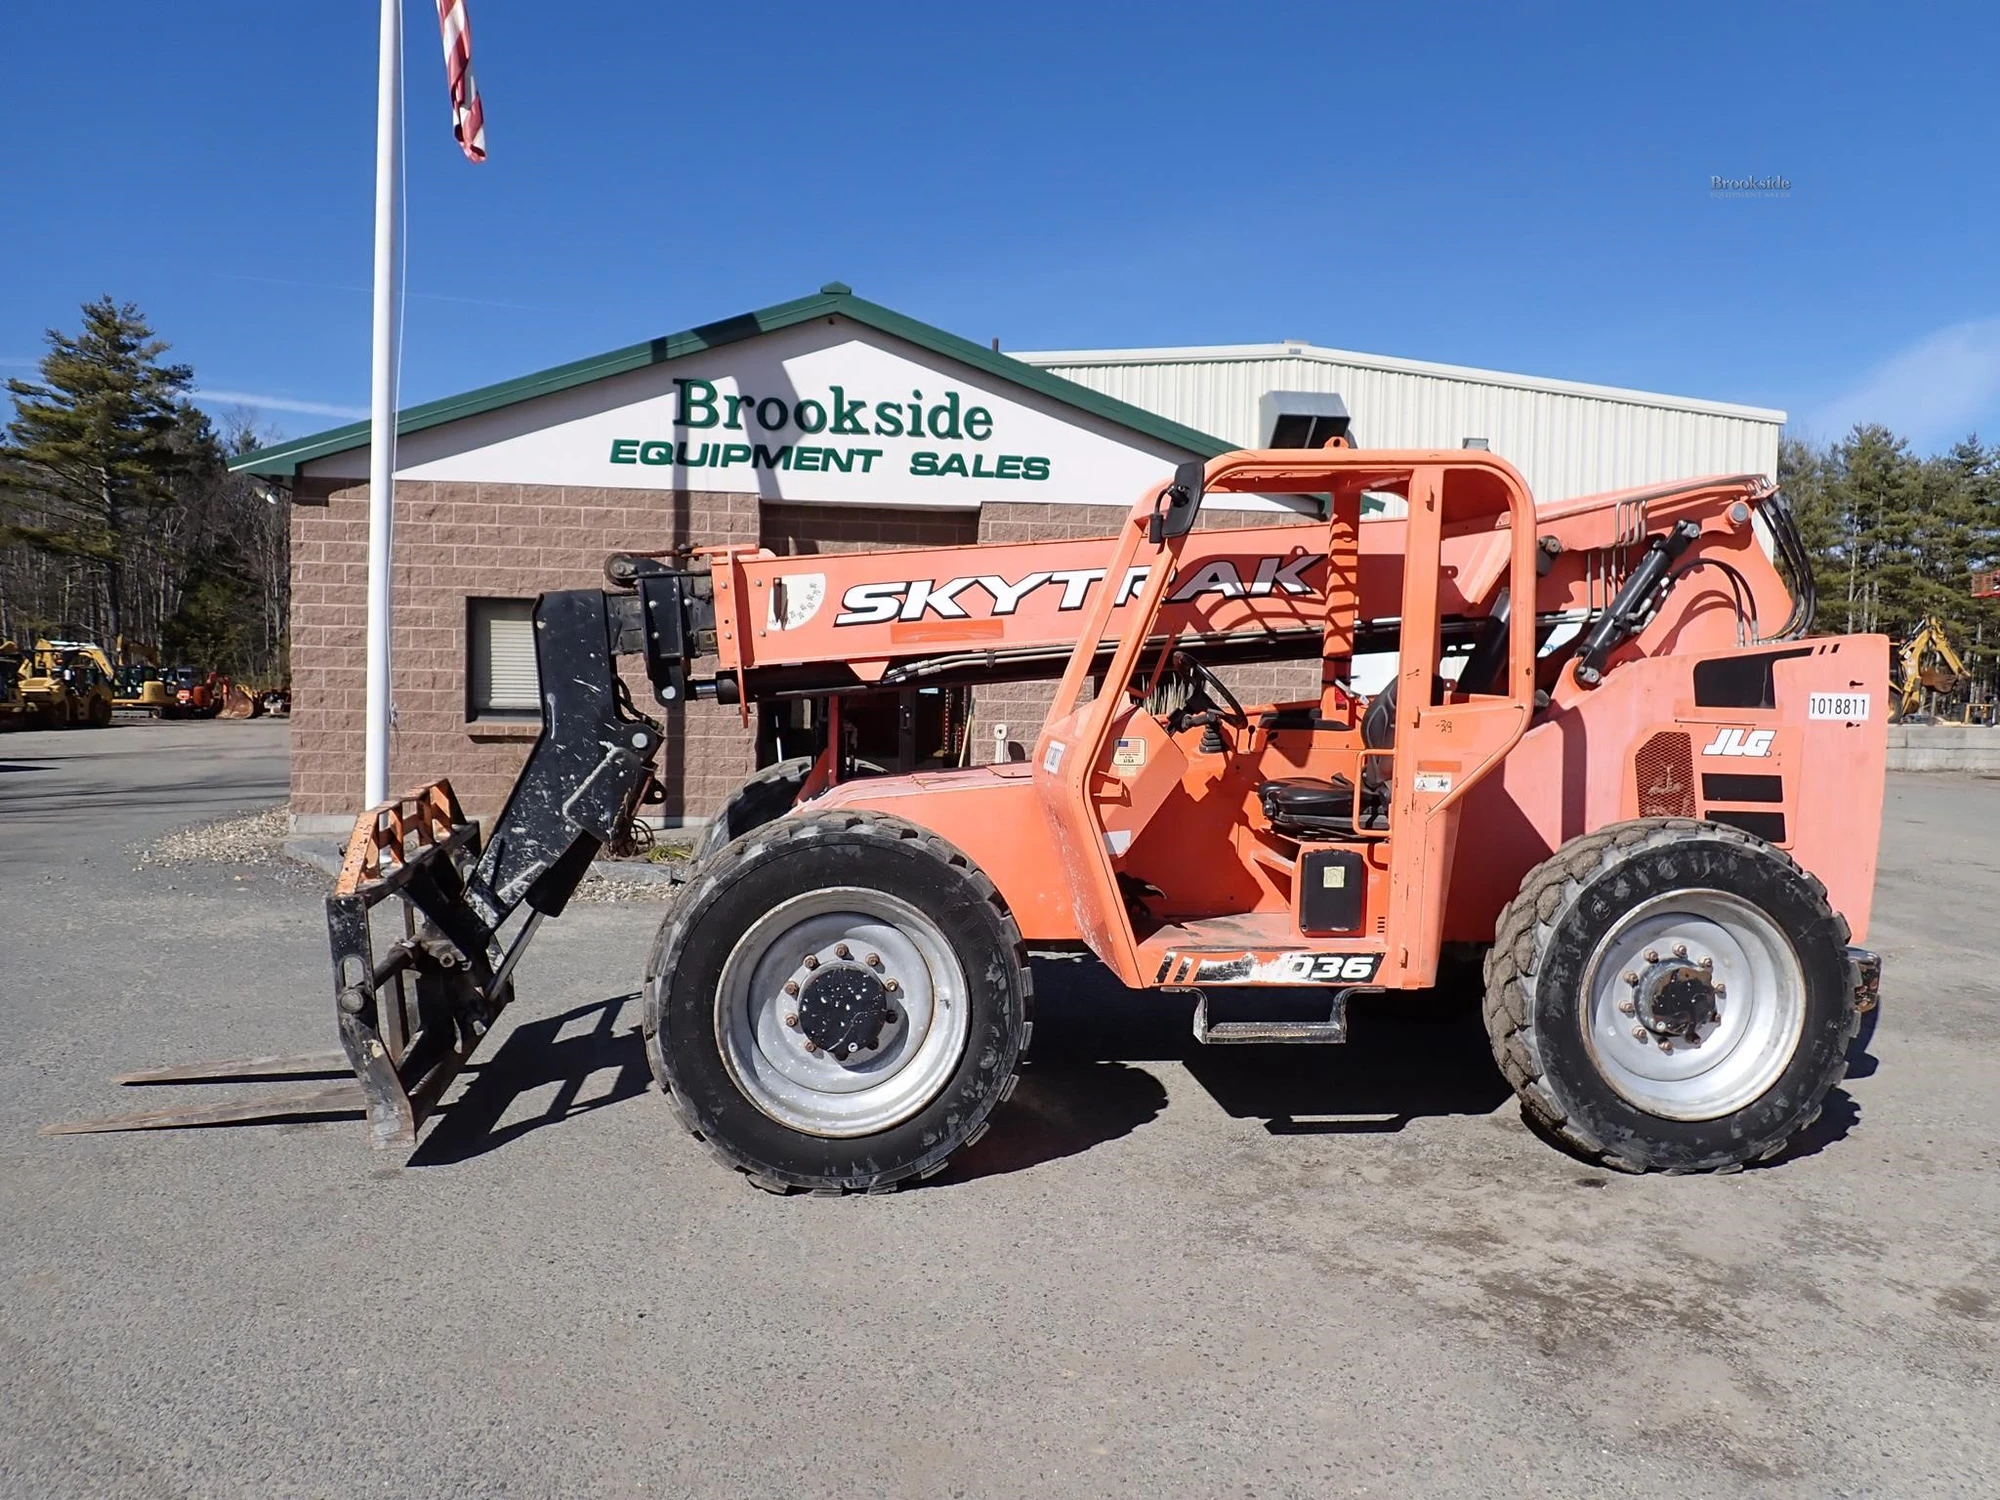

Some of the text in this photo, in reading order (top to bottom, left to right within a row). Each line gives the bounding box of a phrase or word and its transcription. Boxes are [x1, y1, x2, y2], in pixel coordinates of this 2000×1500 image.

[672, 377, 994, 440] Brookside
[609, 439, 1051, 481] EQUIPMENT SALES
[1810, 697, 1867, 716] 1018811
[1702, 728, 1777, 757] JLG
